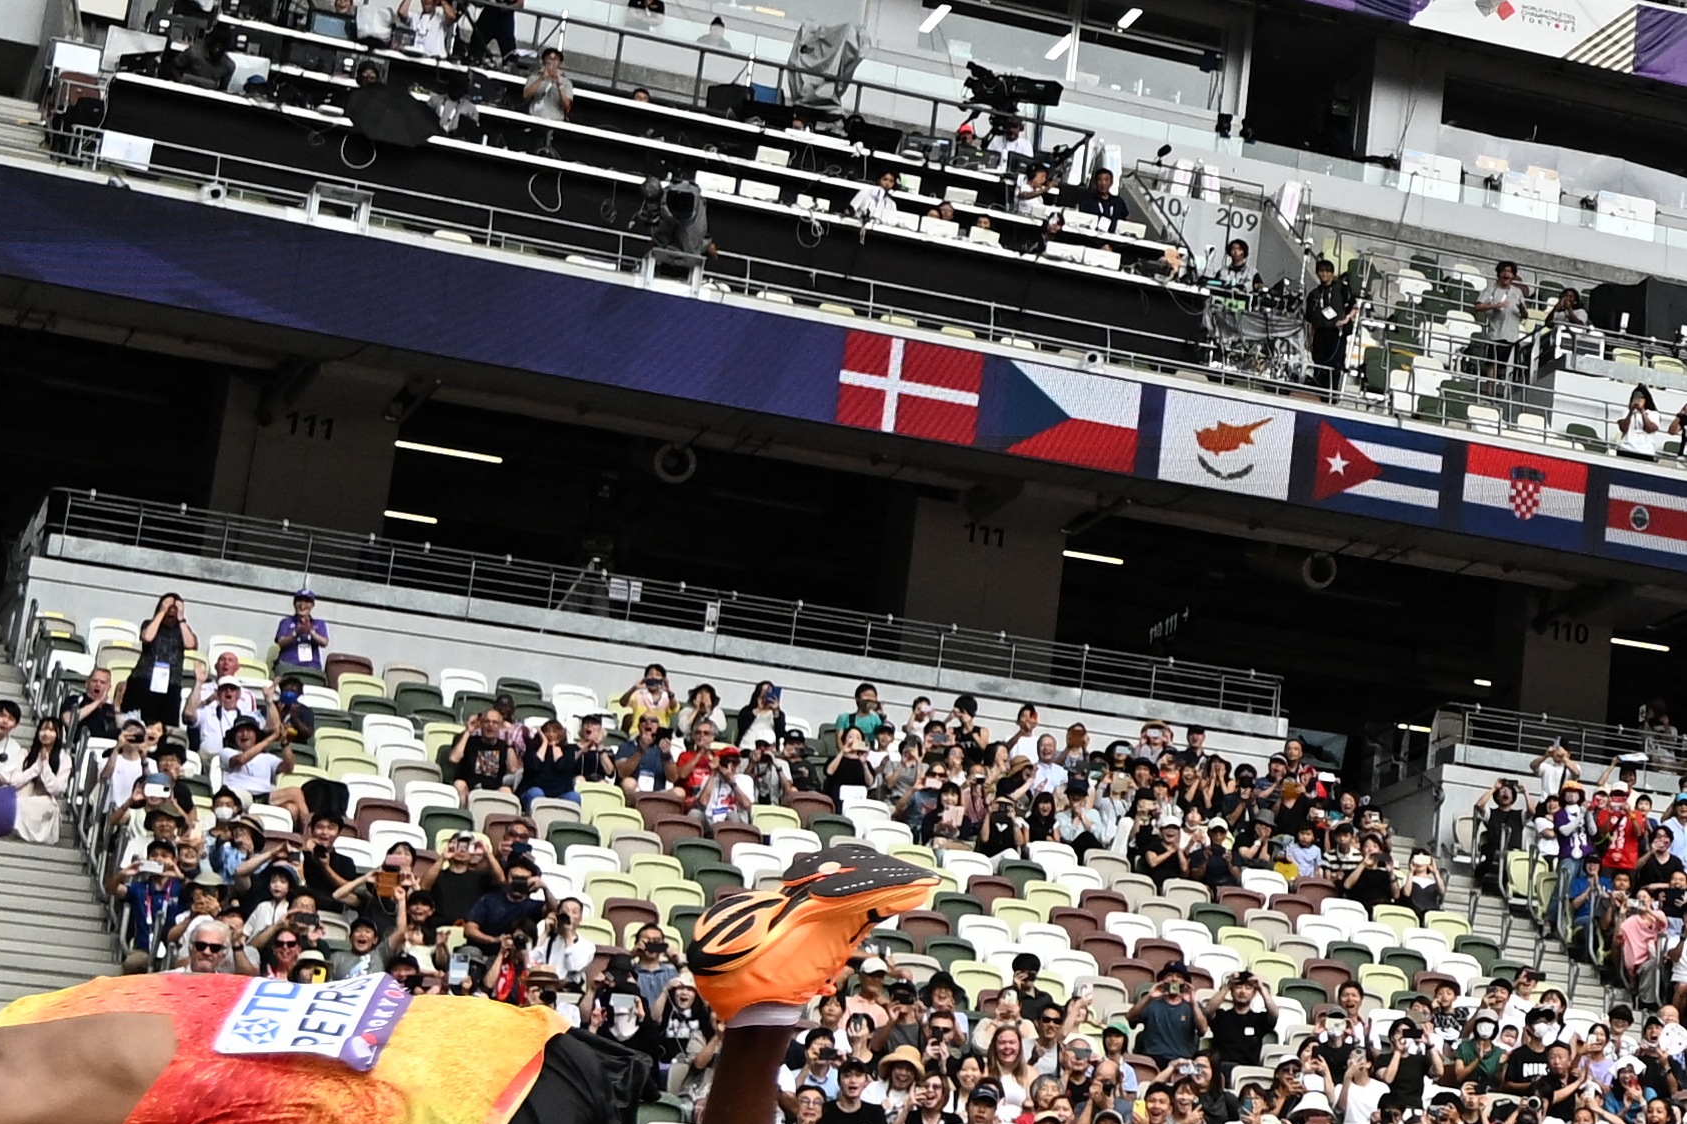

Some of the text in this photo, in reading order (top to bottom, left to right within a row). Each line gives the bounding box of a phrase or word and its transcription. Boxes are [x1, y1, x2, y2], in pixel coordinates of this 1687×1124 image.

[1216, 207, 1259, 232] 209
[287, 412, 334, 440] 111
[964, 522, 1005, 547] 111
[1550, 621, 1589, 644] 110
[1523, 1062, 1550, 1077] NIK
